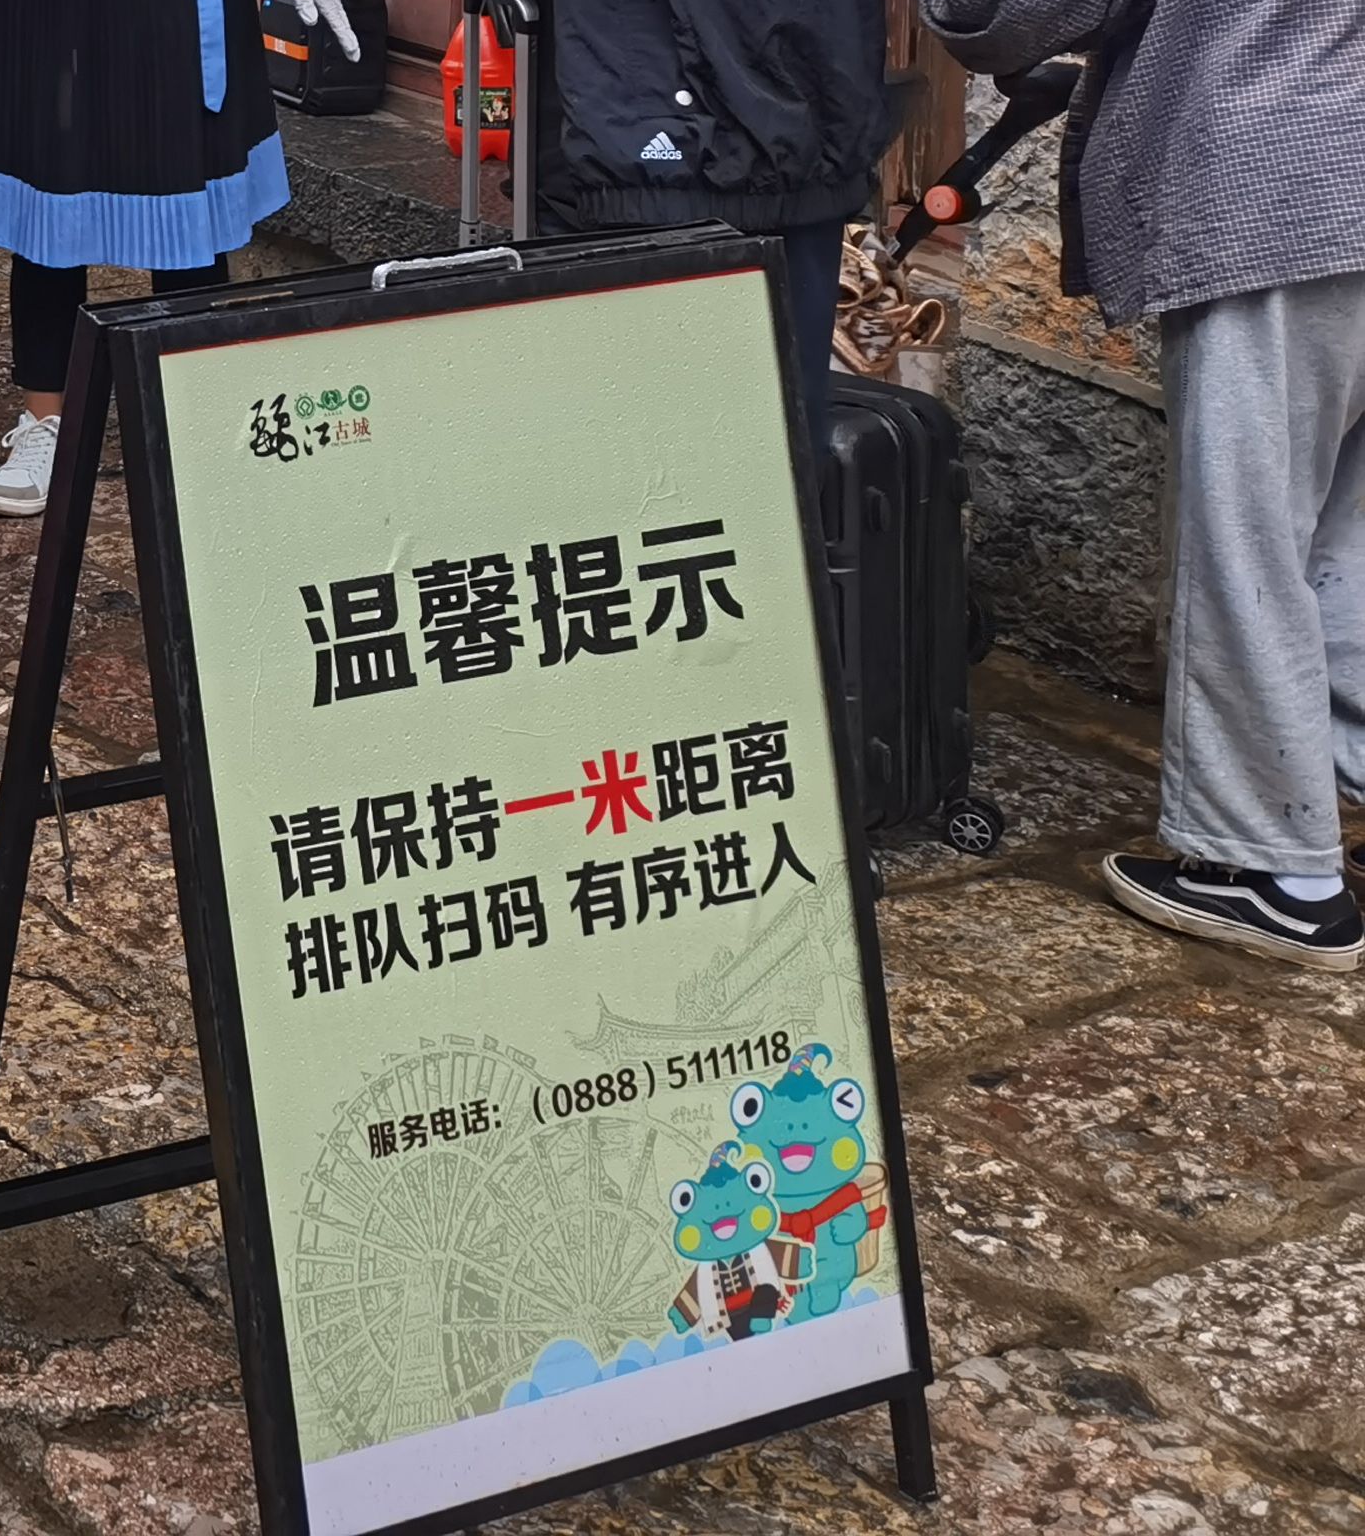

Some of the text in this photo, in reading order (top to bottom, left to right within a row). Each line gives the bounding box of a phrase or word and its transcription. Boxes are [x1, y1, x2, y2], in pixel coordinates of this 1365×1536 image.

[640, 149, 683, 160] adidas
[297, 518, 745, 709] 温馨提示
[269, 720, 795, 902] 请保持一米距离
[284, 821, 817, 1001] 排队扫码 有序进入
